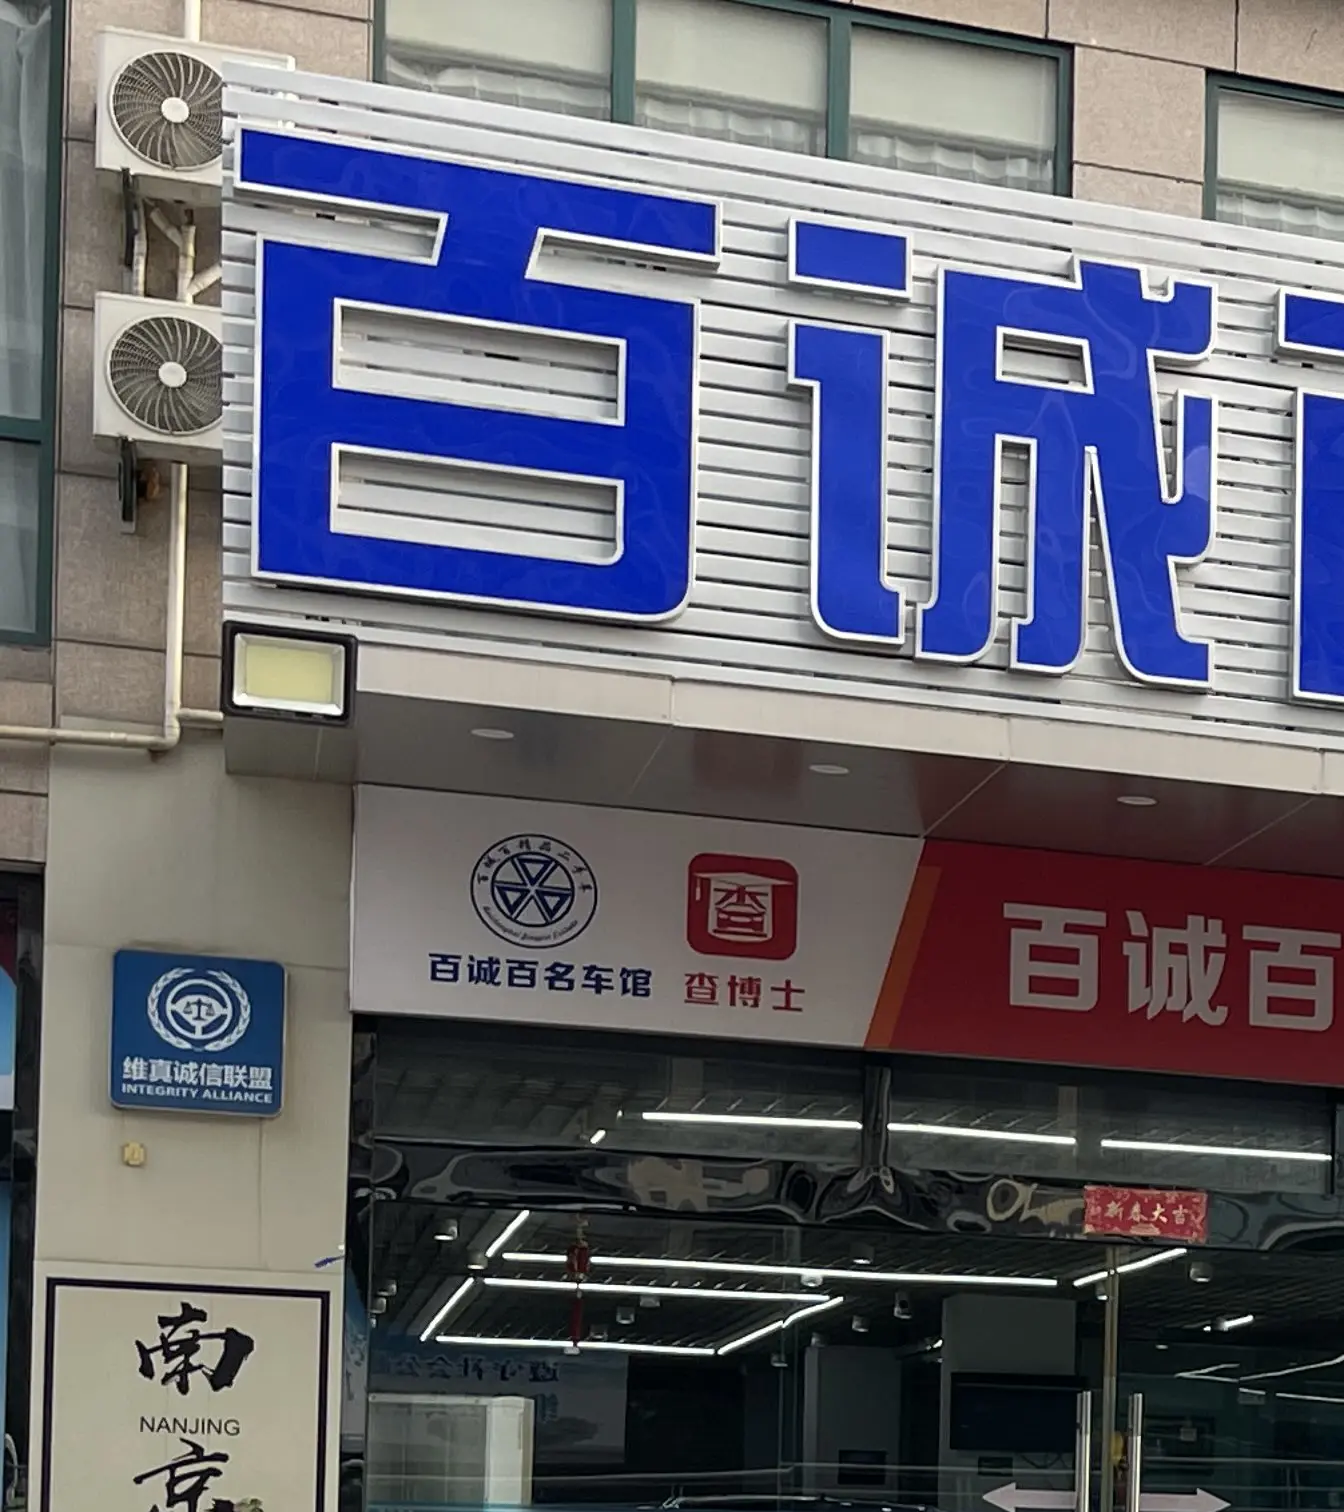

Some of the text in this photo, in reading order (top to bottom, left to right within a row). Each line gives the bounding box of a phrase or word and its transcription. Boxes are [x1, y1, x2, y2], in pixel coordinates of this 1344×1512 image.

[428, 952, 653, 998] 百诚百名车馆
[684, 971, 806, 1013] 查博士
[122, 1056, 273, 1090] 维真诚信联盟
[122, 1083, 273, 1104] INTEGRITY ALLIANCE
[1104, 1200, 1189, 1225] 新春大吉
[135, 1301, 255, 1396] 南
[139, 1415, 241, 1437] NANJING
